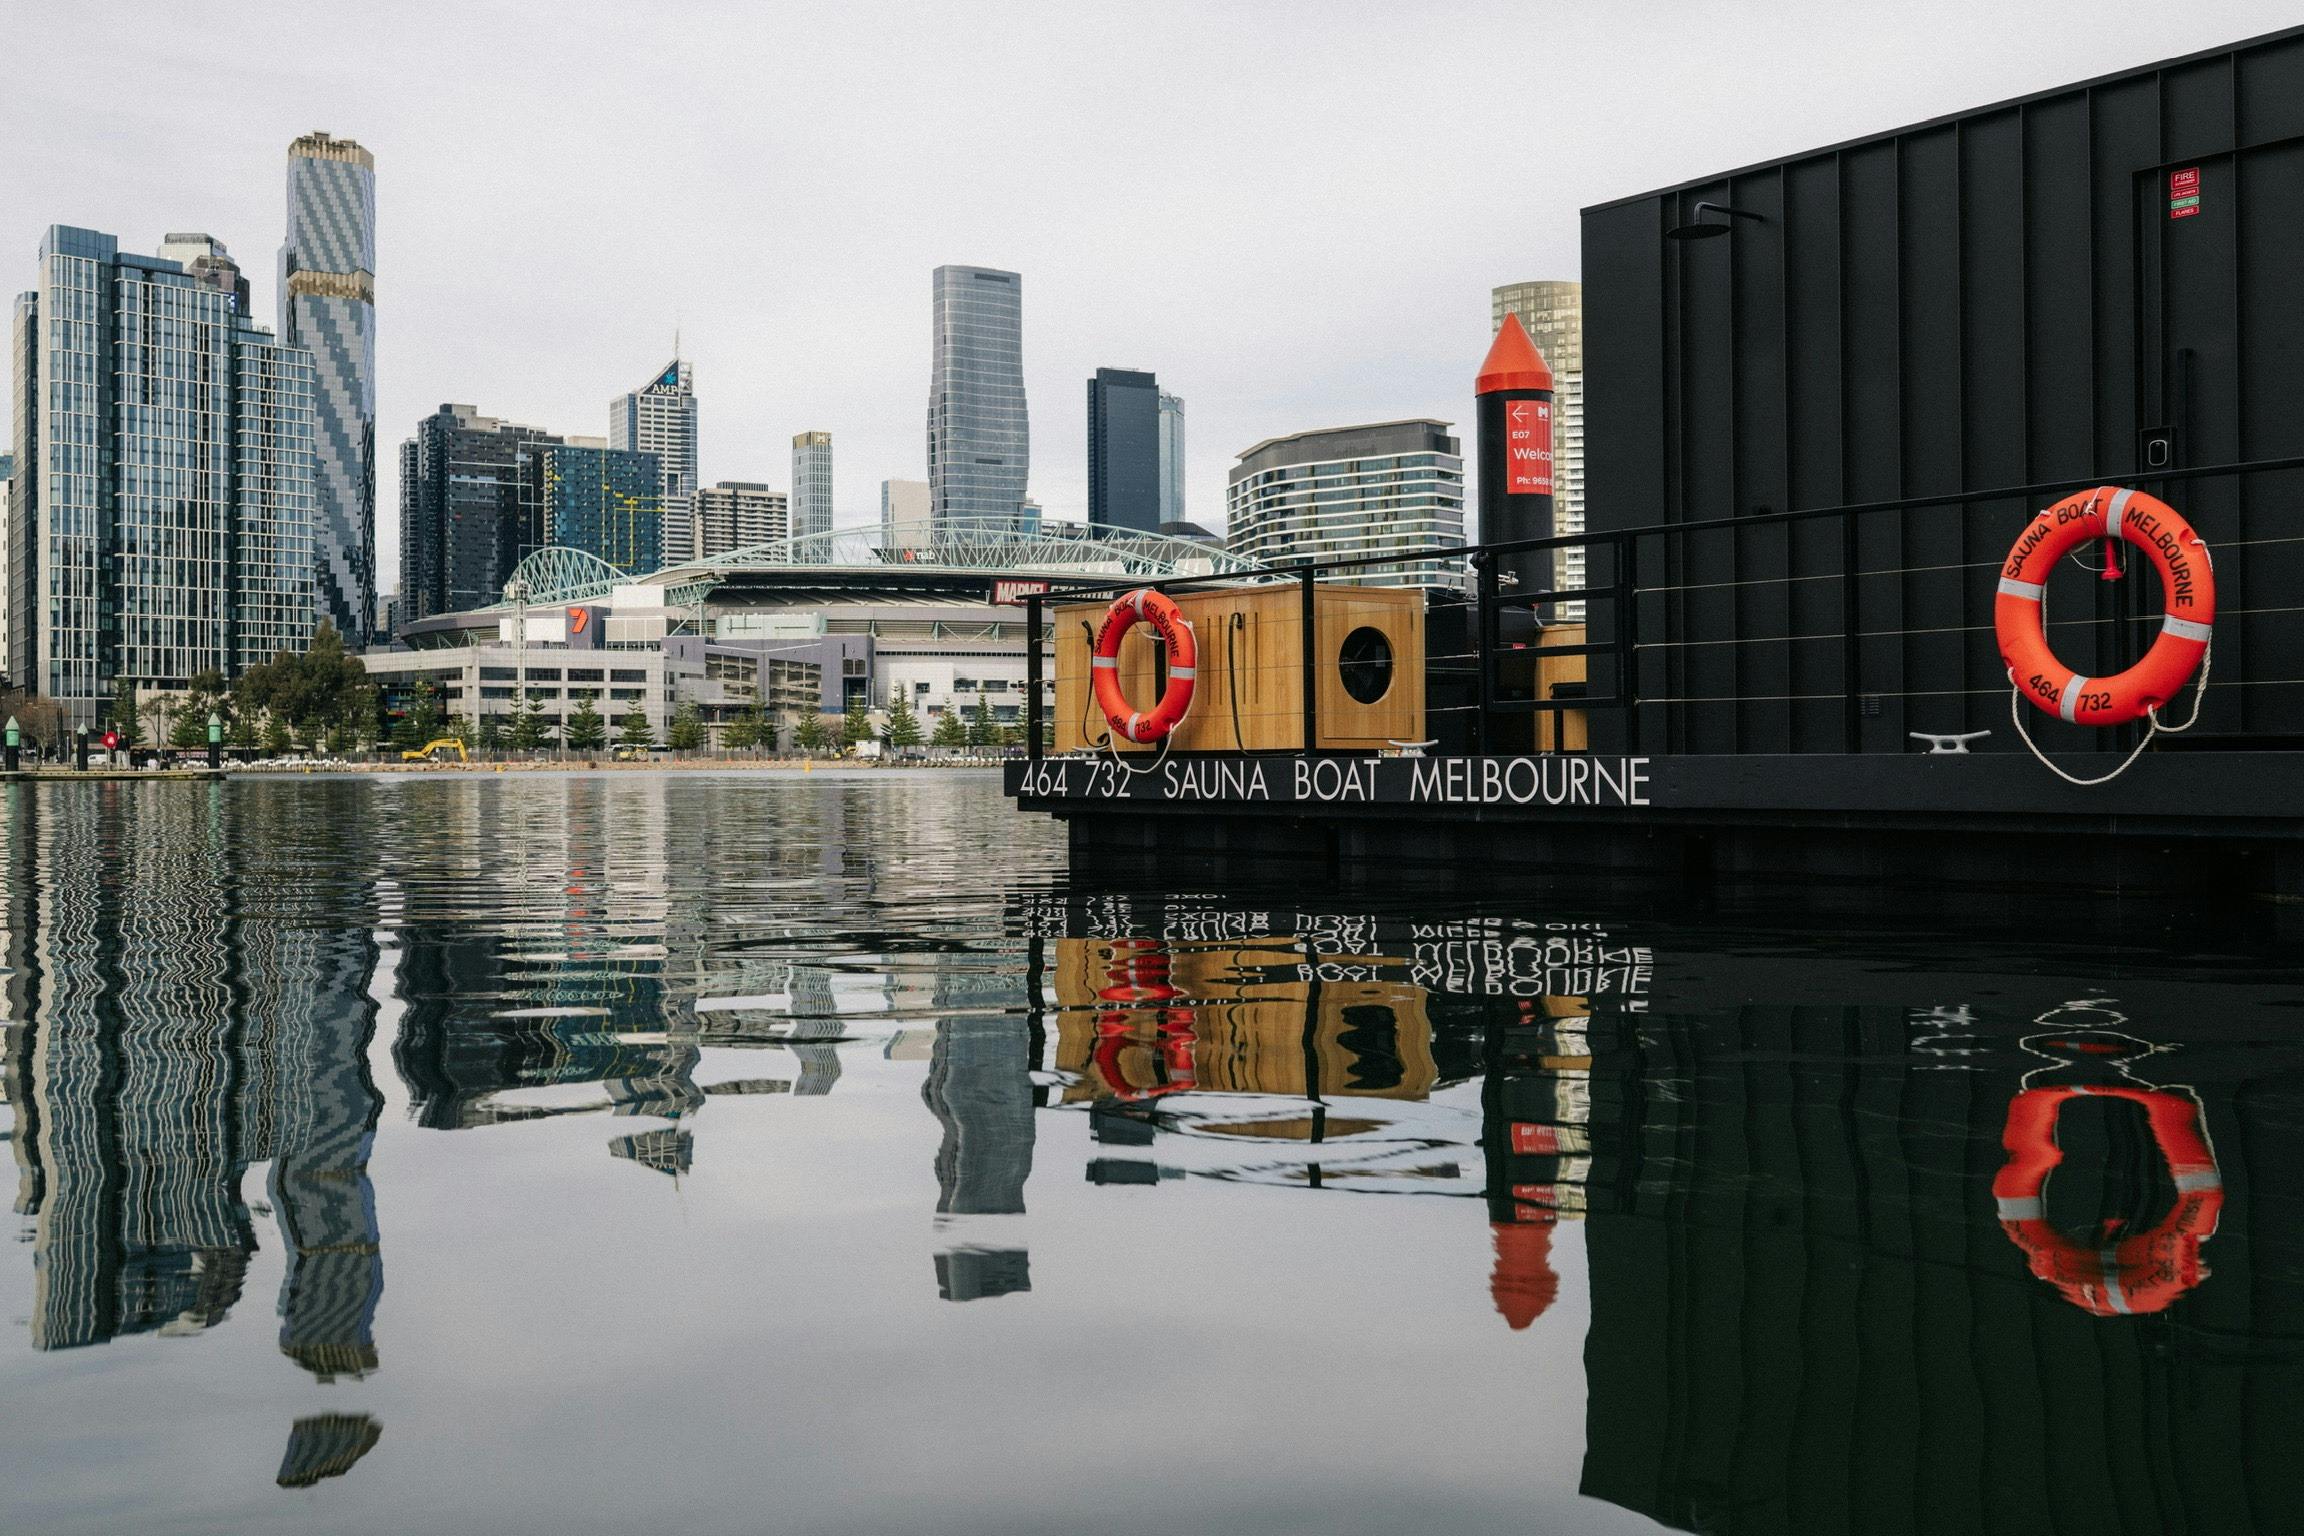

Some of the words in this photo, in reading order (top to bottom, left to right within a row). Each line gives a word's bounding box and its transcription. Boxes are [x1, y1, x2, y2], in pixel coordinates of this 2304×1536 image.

[2175, 172, 2195, 181] FIRE
[652, 384, 678, 395] AMP
[1512, 431, 1530, 439] E07
[1514, 448, 1552, 460] Welco
[2007, 523, 2051, 578] SAUNA
[2125, 507, 2193, 608] MELBOURNE
[567, 608, 588, 633] 7
[1095, 617, 1113, 654] SAUNA
[1143, 600, 1180, 658] MELBOURNE
[2029, 674, 2060, 704] 464
[2081, 692, 2112, 712] 732
[1112, 715, 1127, 732] 464
[1136, 721, 1152, 734] 732
[1020, 761, 1068, 797] 464
[1084, 760, 1131, 798] 732
[1163, 760, 1270, 800] SAUNA
[1295, 758, 1381, 801] BOAT
[1410, 757, 1650, 806] MELBOURNE
